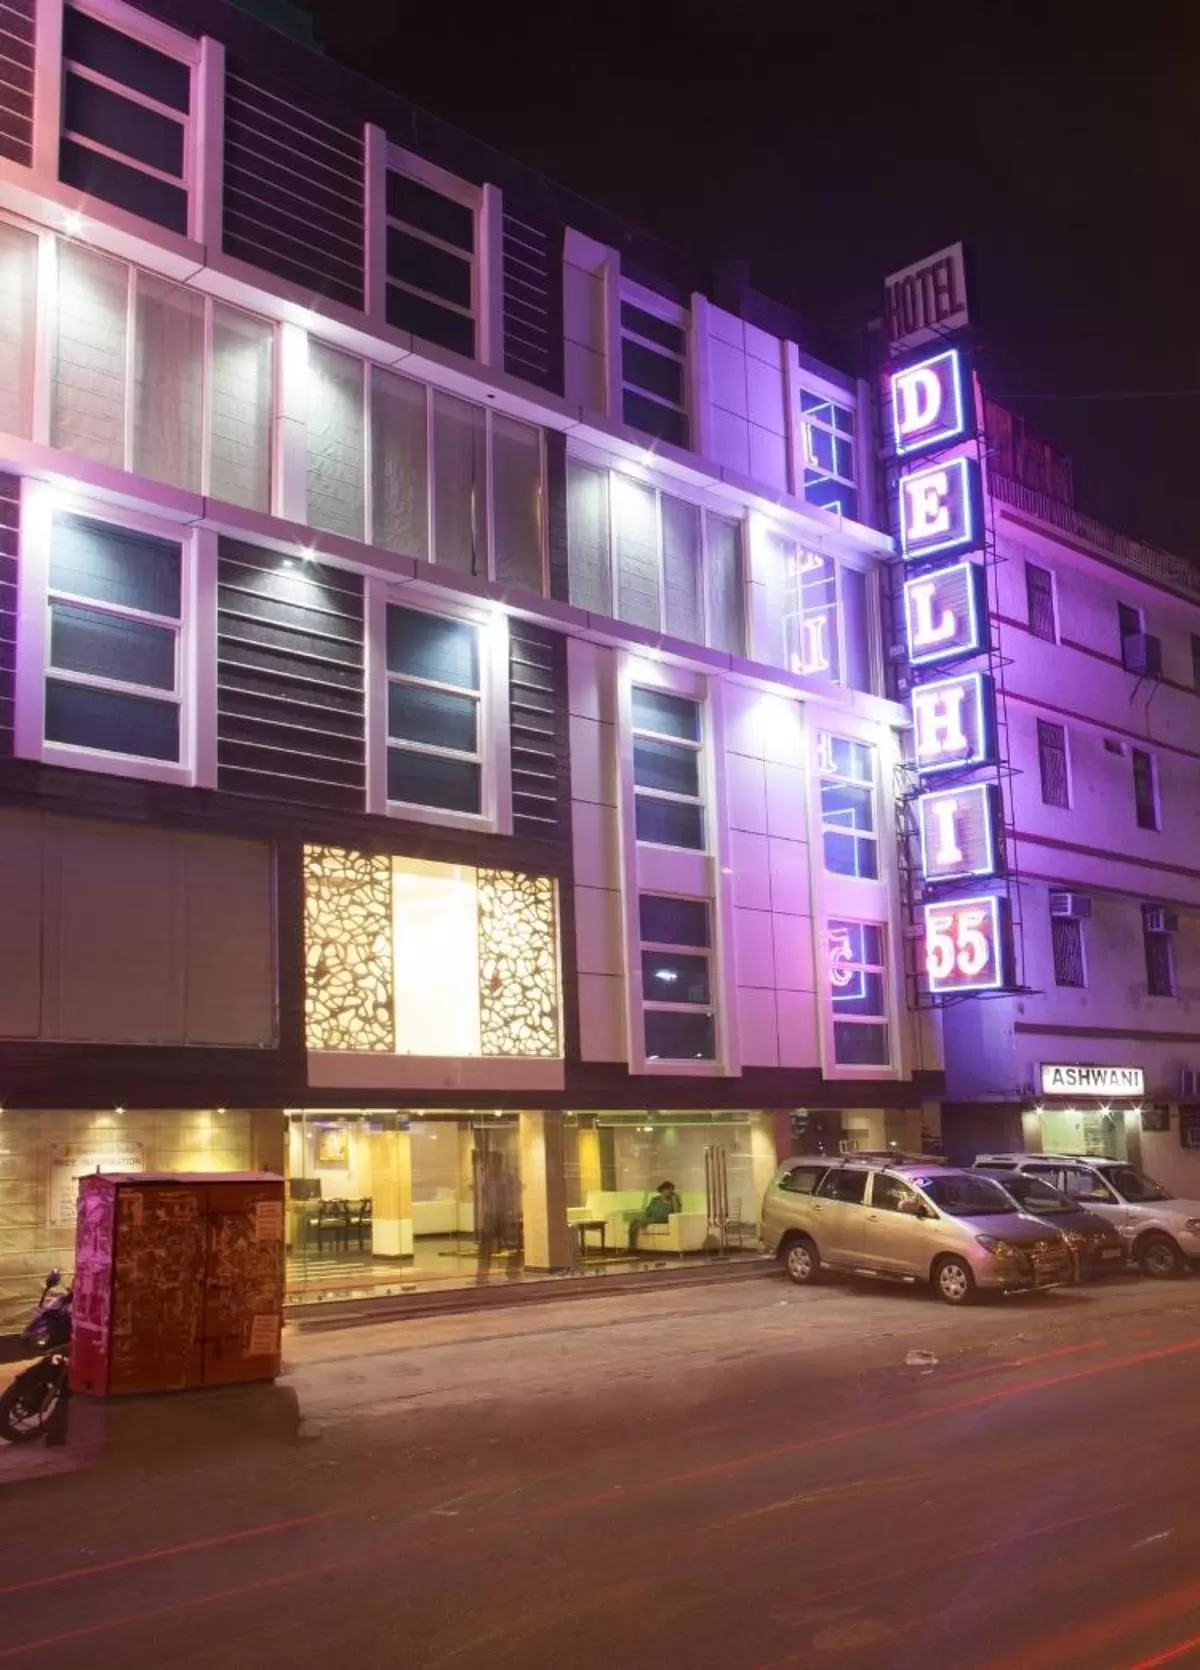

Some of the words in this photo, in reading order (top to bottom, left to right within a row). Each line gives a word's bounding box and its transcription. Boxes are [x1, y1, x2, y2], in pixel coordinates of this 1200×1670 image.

[885, 255, 964, 339] HOTEL
[898, 368, 968, 865] DELHI
[926, 909, 989, 979] 55
[1052, 1068, 1139, 1087] ASHWANI
